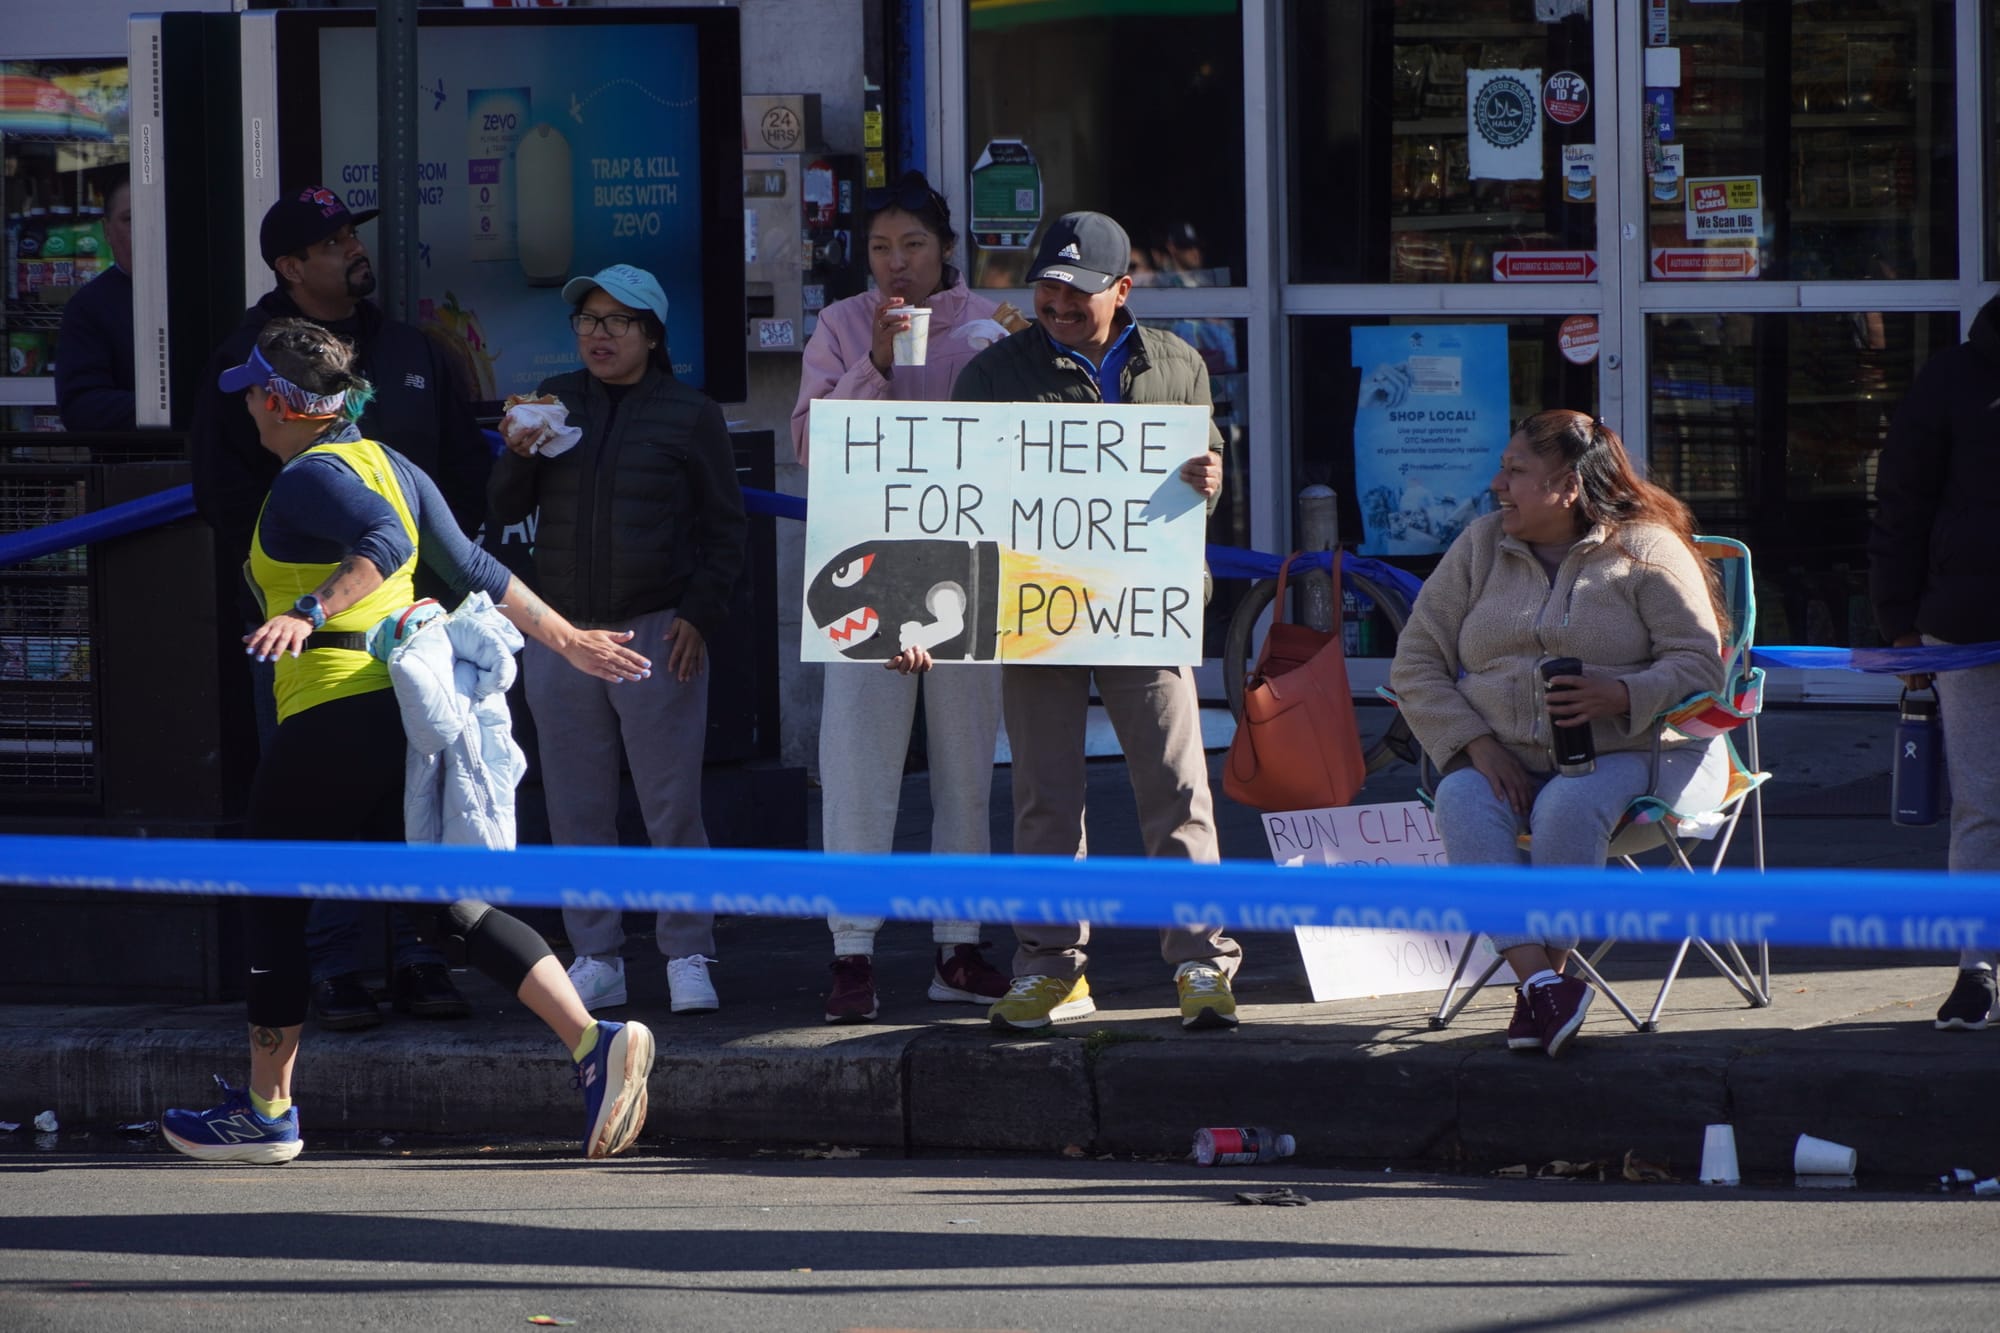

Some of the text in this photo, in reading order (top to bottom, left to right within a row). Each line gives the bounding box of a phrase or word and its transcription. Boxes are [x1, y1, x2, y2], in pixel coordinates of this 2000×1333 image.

[1550, 77, 1571, 89] GOT
[1556, 88, 1568, 101] ID
[1487, 97, 1522, 119] حلال
[484, 114, 517, 132] zevo
[769, 112, 793, 129] 24
[1491, 119, 1518, 128] HALAL
[767, 129, 796, 142] HRS
[343, 165, 369, 183] GOT
[417, 162, 447, 181] ROM
[592, 156, 680, 179] TRAP & KILL
[594, 184, 677, 207] BUGS WITH
[1699, 187, 1721, 200] We
[1696, 196, 1726, 210] Card
[612, 211, 662, 240] zevo
[1696, 214, 1753, 229] We Scan IDs
[1511, 261, 1582, 271] AUTOMATIC SLIDING DOOR
[1670, 258, 1700, 268] AUTOMATIC
[1389, 410, 1477, 422] SHOP LOCAL!
[1412, 428, 1427, 436] your
[1428, 428, 1454, 436] grocery
[844, 416, 1168, 475] HIT HERE
[1404, 436, 1420, 444] OTC
[1385, 448, 1399, 456] your
[1428, 447, 1465, 455] community
[884, 483, 1150, 552] FOR MORE
[1018, 582, 1192, 639] POWER
[1268, 812, 1341, 852] RUN
[1384, 938, 1455, 978] YOU!
